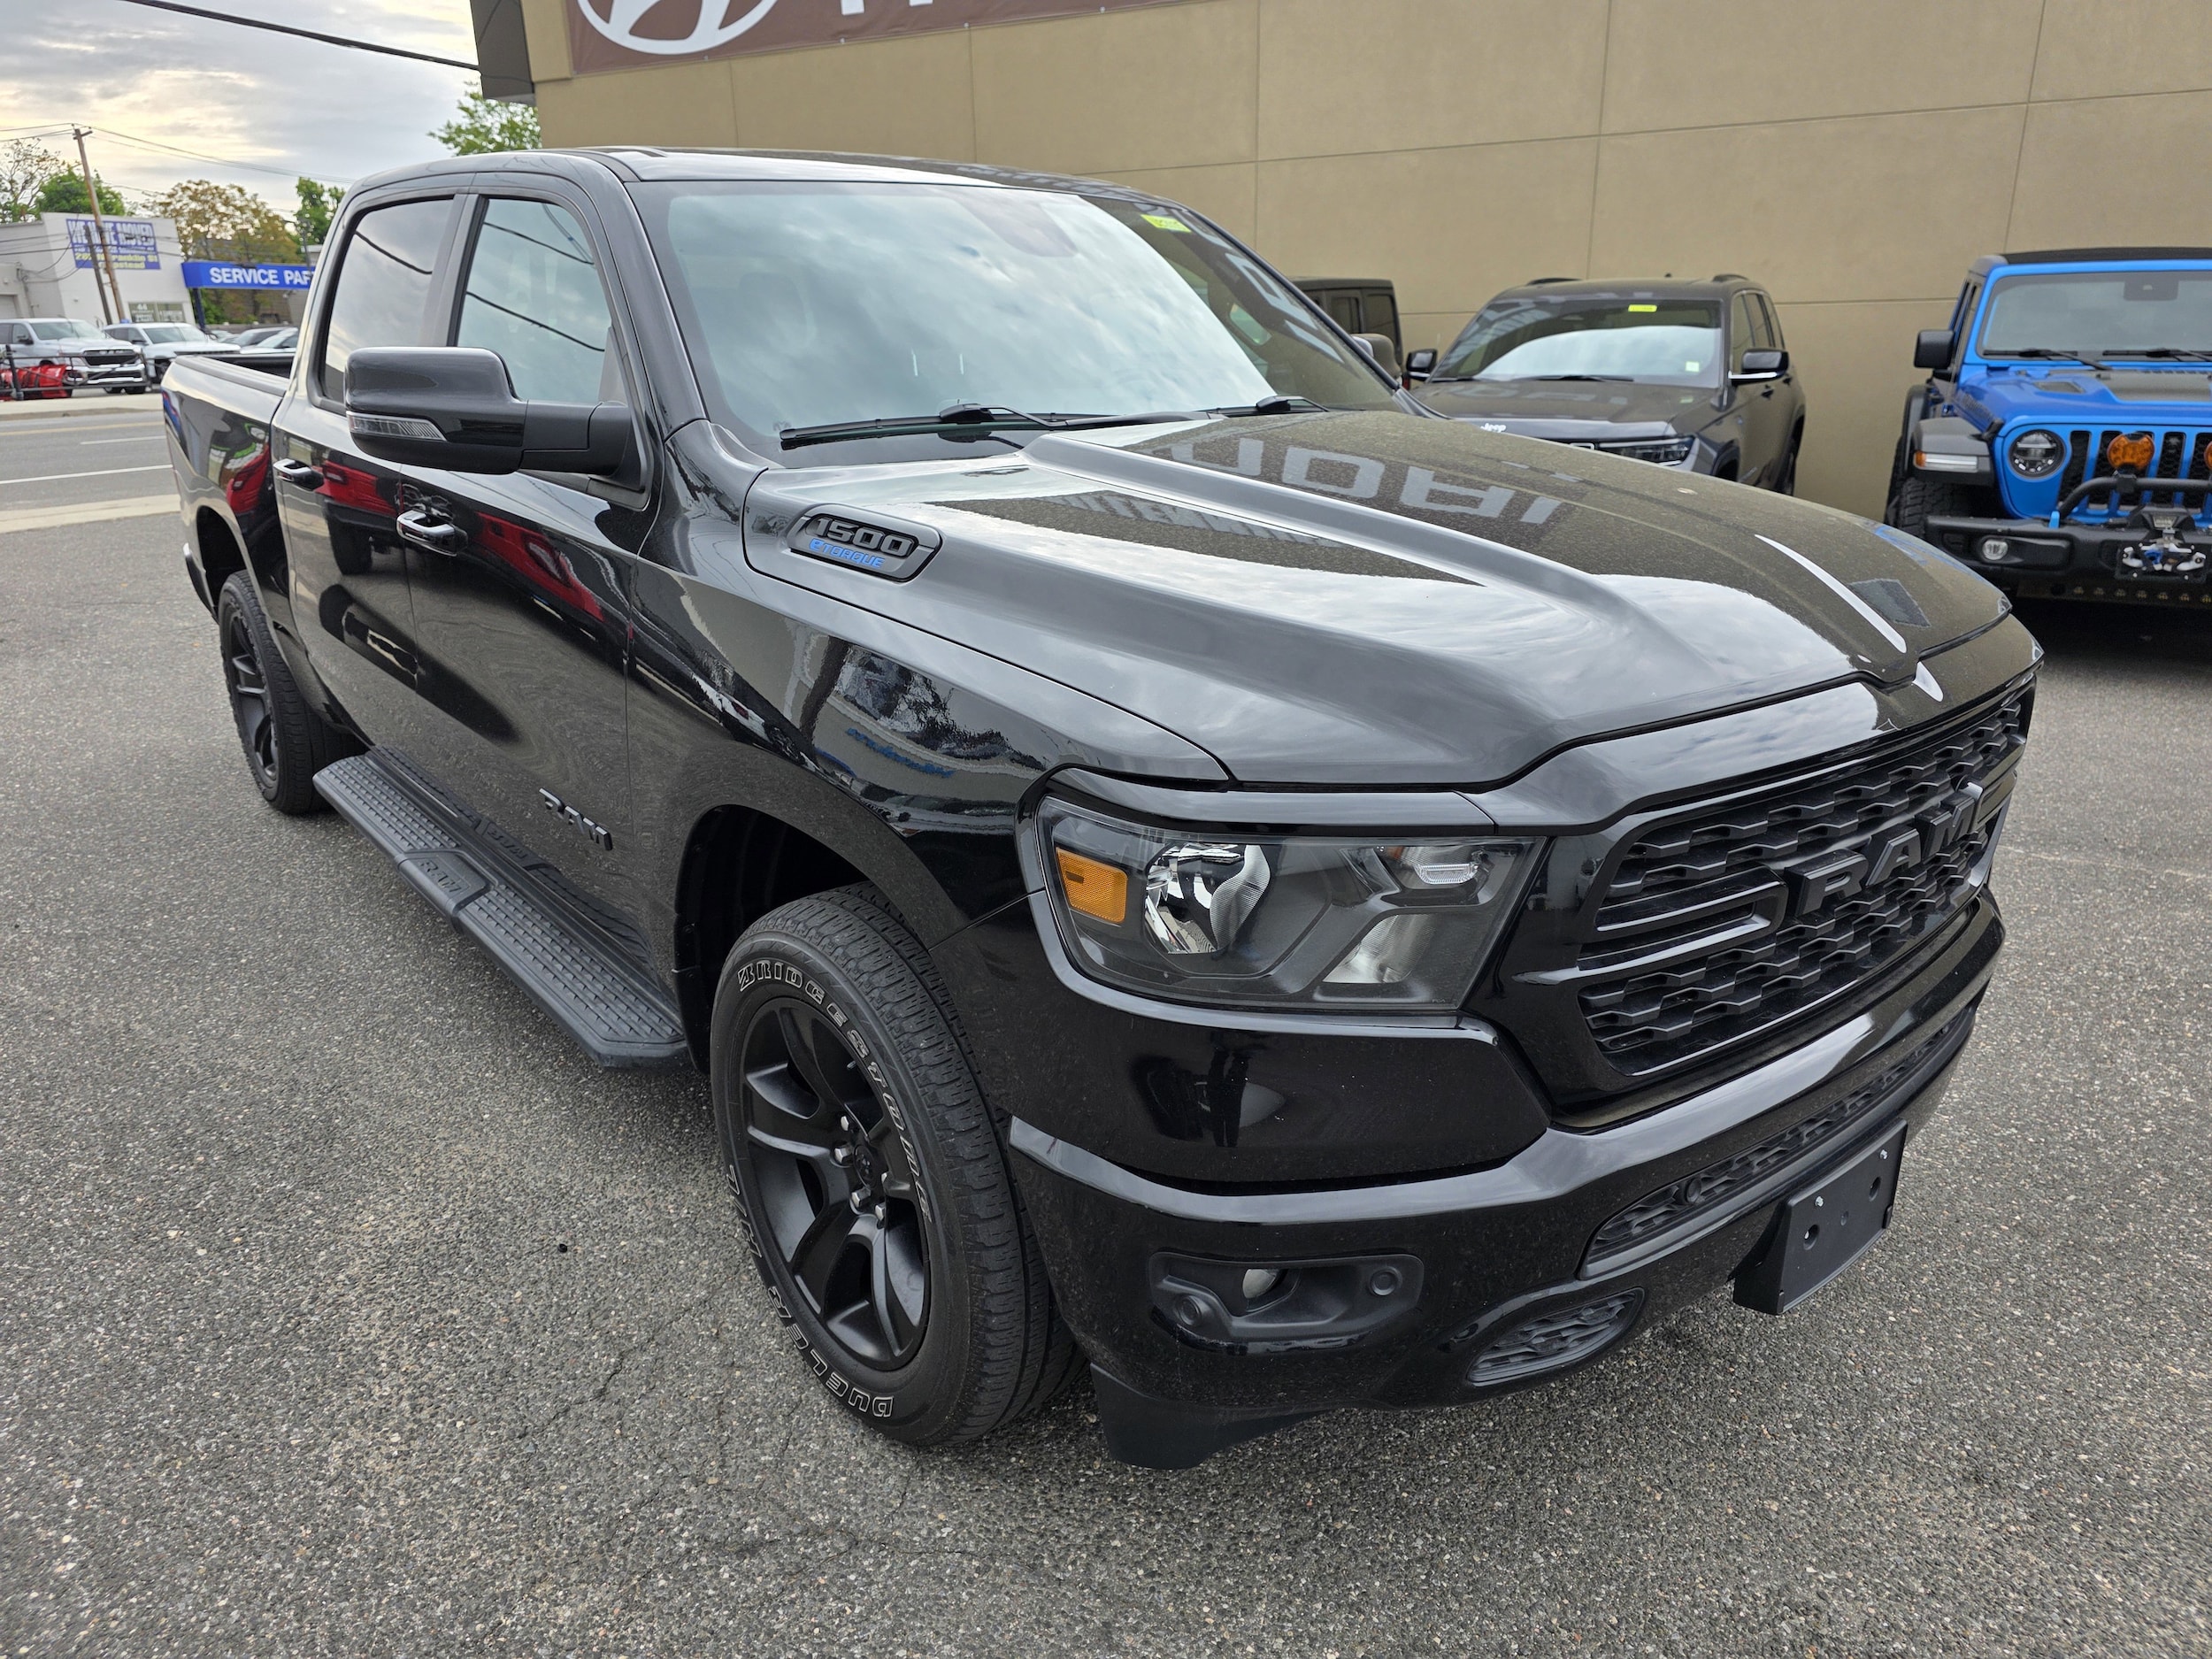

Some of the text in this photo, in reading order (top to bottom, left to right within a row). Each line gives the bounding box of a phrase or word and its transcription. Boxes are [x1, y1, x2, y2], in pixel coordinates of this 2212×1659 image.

[116, 223, 155, 246] MOVED
[210, 267, 279, 285] SERVICE
[817, 517, 916, 557] 1500
[1791, 795, 1977, 918] RAM
[736, 959, 933, 1224] BRIDGESTONE
[767, 1286, 895, 1417] DUELER
